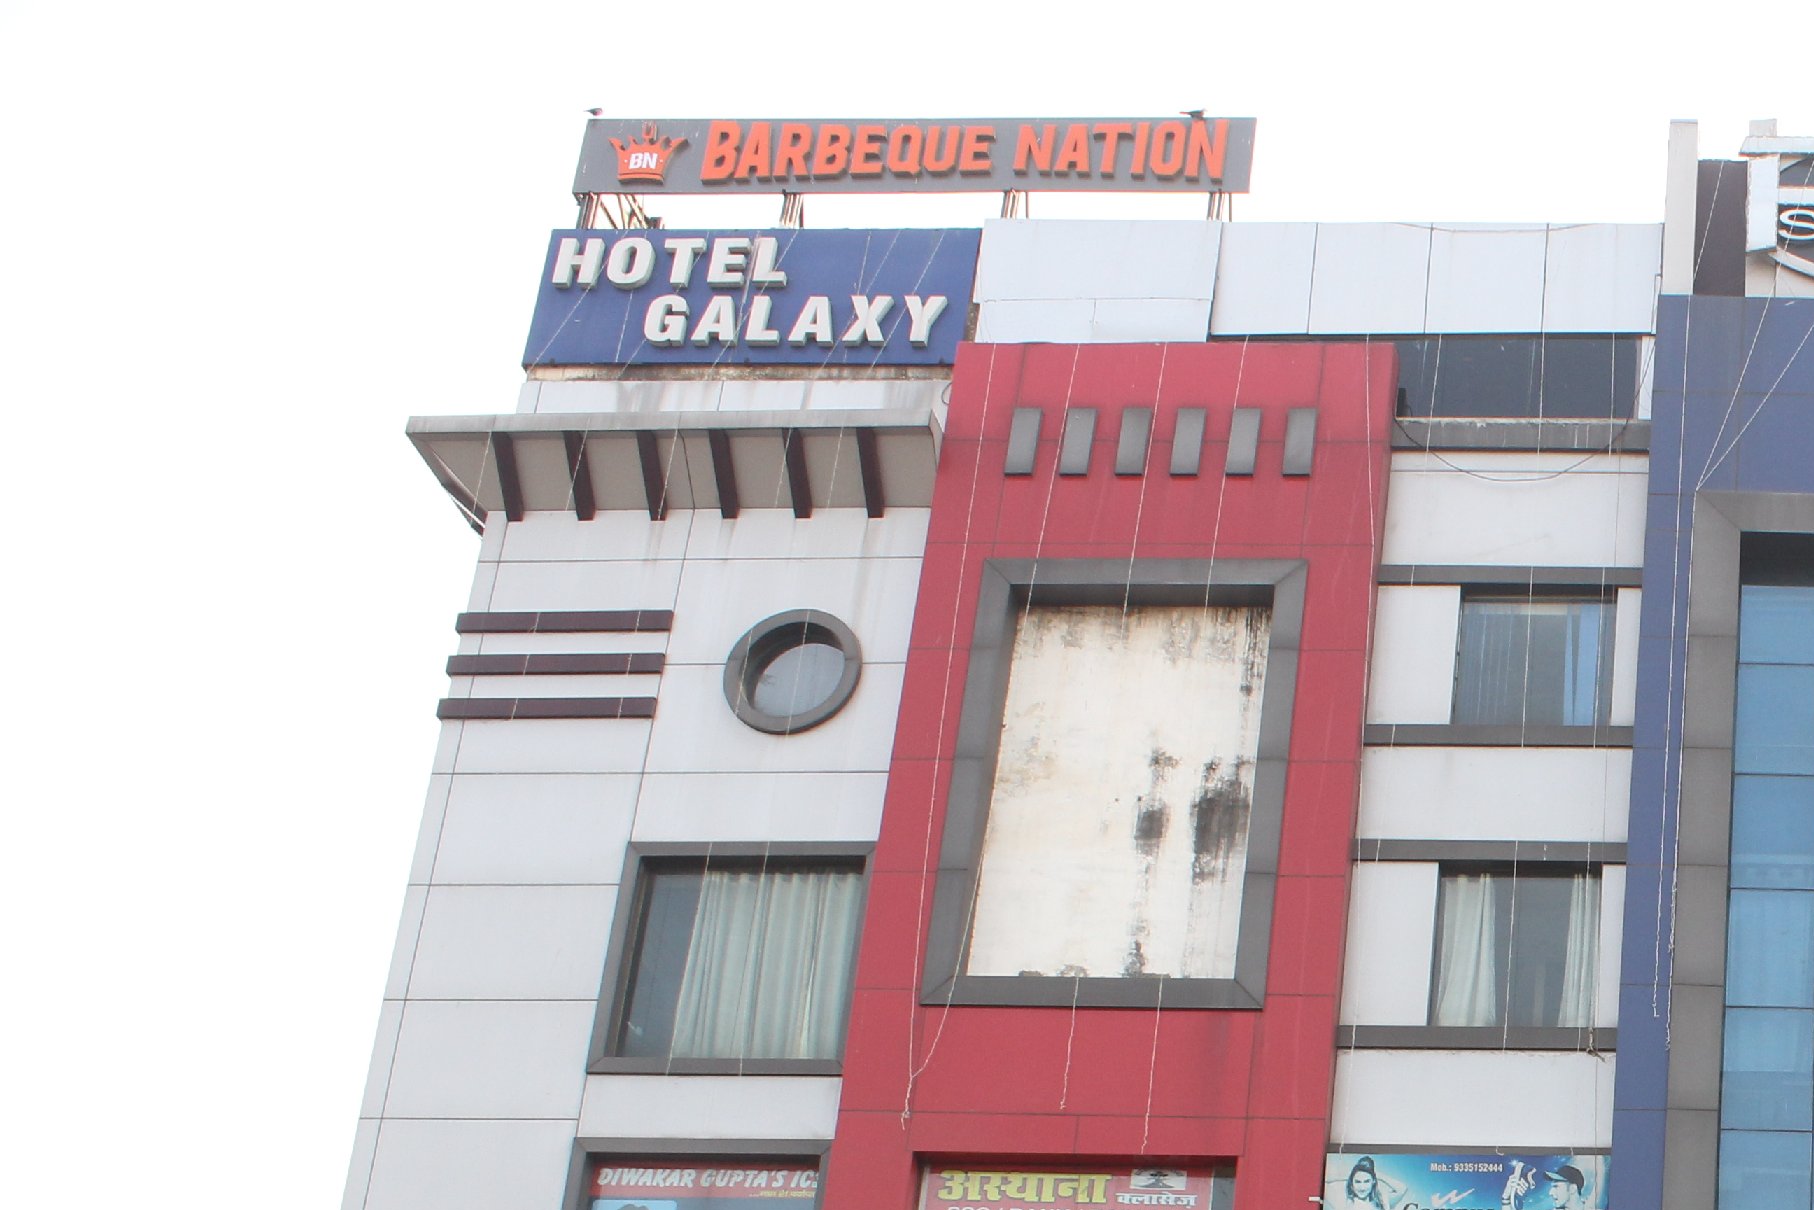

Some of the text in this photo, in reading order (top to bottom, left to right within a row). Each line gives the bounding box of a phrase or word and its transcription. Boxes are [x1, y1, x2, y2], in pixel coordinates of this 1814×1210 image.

[629, 152, 657, 169] BN
[700, 118, 1228, 183] BARBEQUE NATION
[552, 237, 787, 289] HOTEL
[643, 294, 948, 347] GALAXY
[598, 1168, 786, 1189] DIWAKAR GUPTA'S
